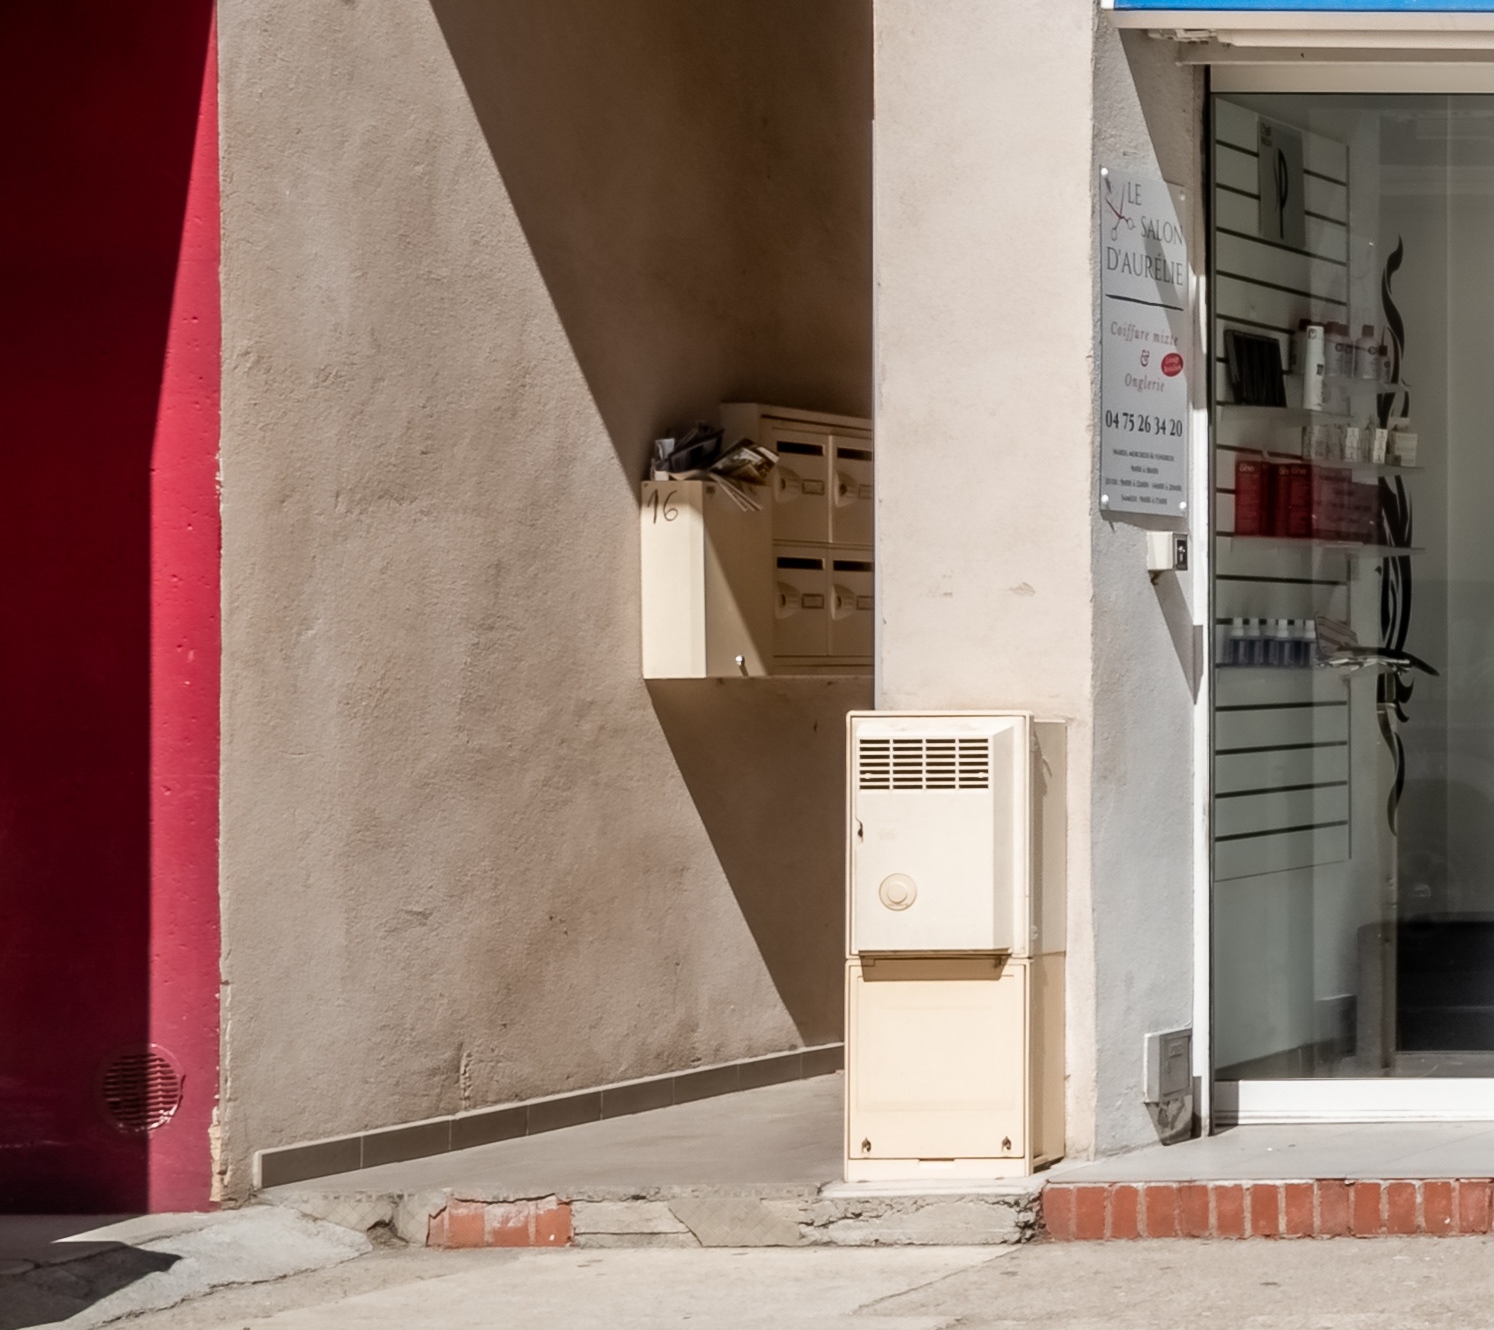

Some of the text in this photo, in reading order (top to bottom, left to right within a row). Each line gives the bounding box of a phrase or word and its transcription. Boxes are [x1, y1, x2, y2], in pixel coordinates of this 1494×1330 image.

[1127, 181, 1142, 206] LE
[1140, 215, 1184, 246] SALON
[1106, 245, 1184, 286] D'AURÉLIE
[1111, 320, 1151, 343] Coiffure
[1124, 373, 1165, 392] Onglerie
[1105, 409, 1183, 438] 04 75 26 34 20
[646, 489, 679, 525] 16
